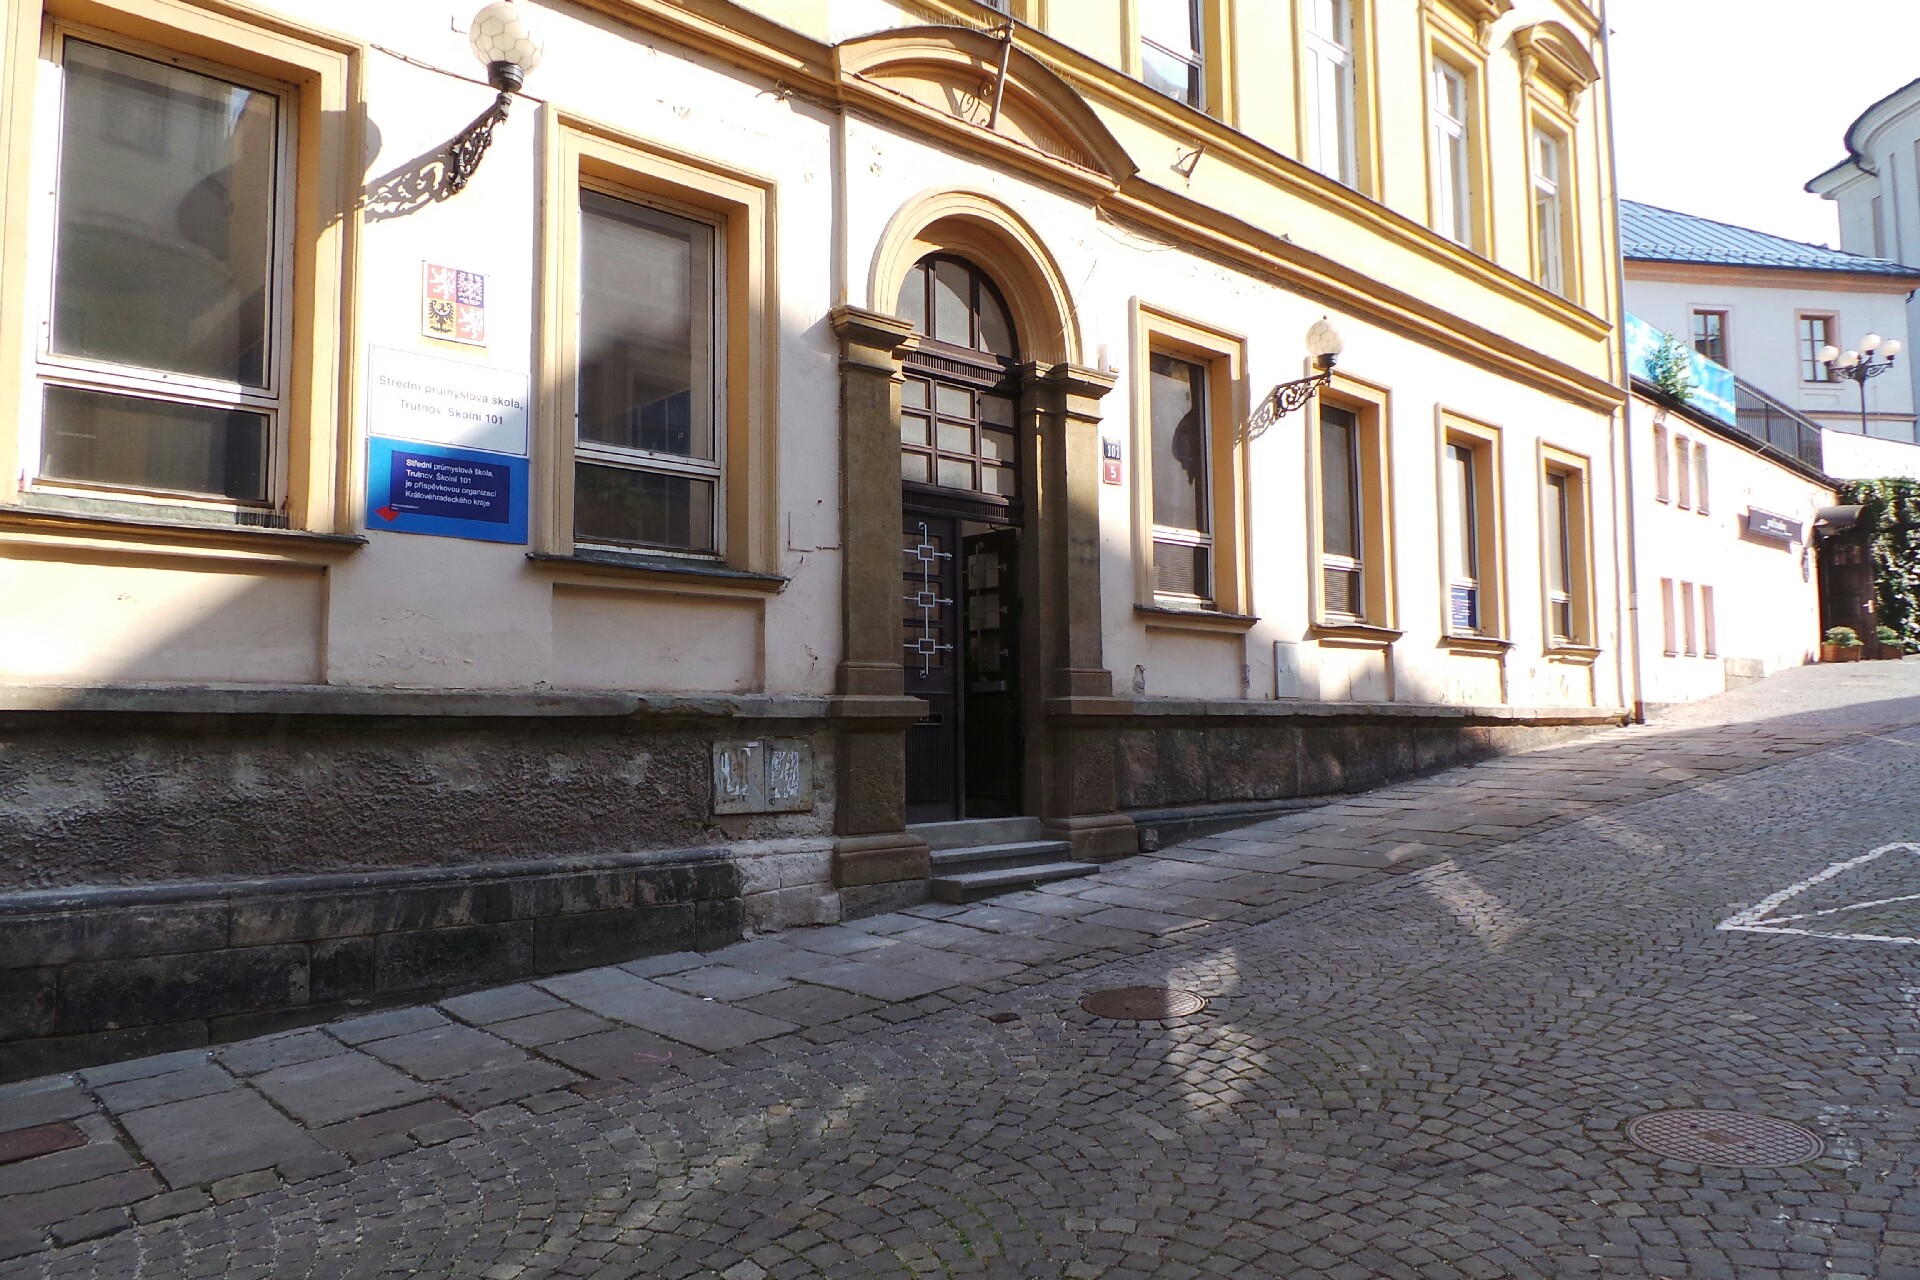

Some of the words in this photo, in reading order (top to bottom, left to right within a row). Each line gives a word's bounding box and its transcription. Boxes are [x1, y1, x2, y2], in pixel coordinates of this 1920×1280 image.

[485, 413, 503, 425] 101
[1108, 445, 1120, 458] 101
[406, 459, 432, 469] Střední
[433, 464, 473, 474] průmyslová
[474, 467, 494, 478] škola,
[1110, 466, 1117, 479] 5
[436, 473, 458, 482] Školní
[459, 476, 472, 484] 101
[405, 480, 412, 489] je
[414, 481, 460, 493] příspěvkovou
[405, 490, 472, 504] Královéhradeckého
[473, 498, 491, 508] kraje
